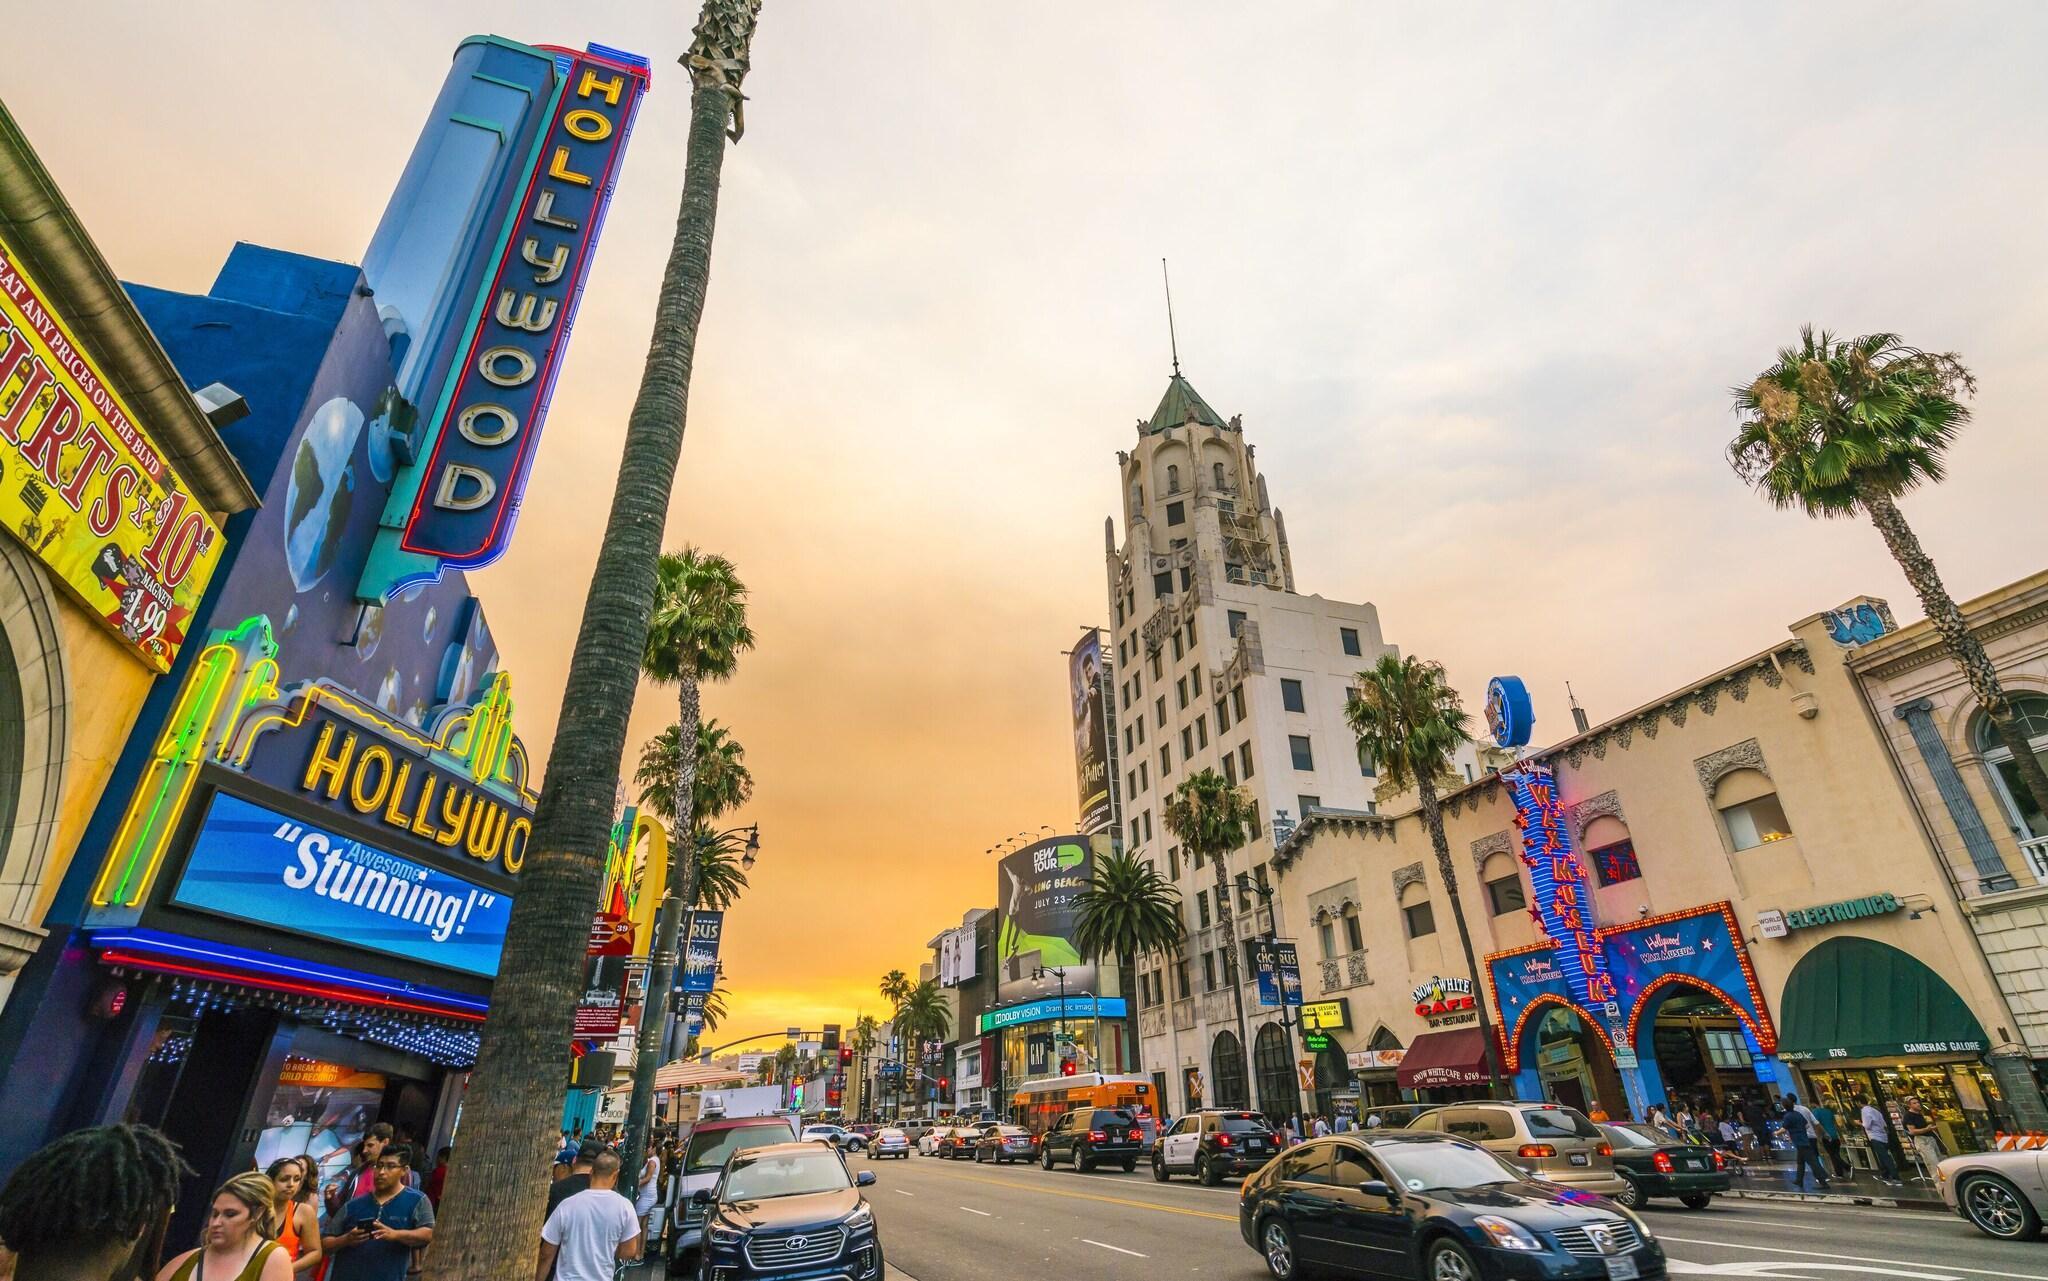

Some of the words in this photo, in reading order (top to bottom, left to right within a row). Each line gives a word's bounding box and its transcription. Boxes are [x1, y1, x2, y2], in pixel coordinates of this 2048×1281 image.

[433, 68, 626, 512] HOLLYWOOD
[21, 298, 54, 338] ANY
[49, 331, 97, 393] PRICES
[93, 388, 115, 417] ON
[111, 409, 136, 444] THE
[131, 441, 160, 475] BLVD
[140, 572, 175, 611] MAGNETS
[1033, 846, 1057, 864] DEW
[1033, 858, 1058, 874] TOUR
[1034, 897, 1050, 909] JULY
[1787, 892, 1898, 930] ELECTRONICS
[616, 924, 629, 932] 39
[1552, 856, 1608, 1002] MUSEUM
[1759, 915, 1782, 926] WORLD
[1763, 924, 1782, 933] WIDE
[1645, 932, 1681, 953] Hollywood
[1411, 981, 1433, 1004] SNOW
[1438, 977, 1471, 993] WHITE
[1002, 1010, 1021, 1022] DOLBY
[1020, 1006, 1041, 1018] VISION
[1045, 1004, 1074, 1013] Dramtic
[1415, 995, 1475, 1017] CAFE
[1030, 1042, 1044, 1066] GAP
[1828, 1048, 1848, 1058] 6765
[1903, 1041, 1948, 1054] CAMERAS
[1949, 1041, 1981, 1052] GALORE
[1413, 1069, 1428, 1084] SNOW
[1428, 1067, 1446, 1077] WHITE
[1445, 1068, 1461, 1081] CAFE
[1464, 1072, 1480, 1081] 6769
